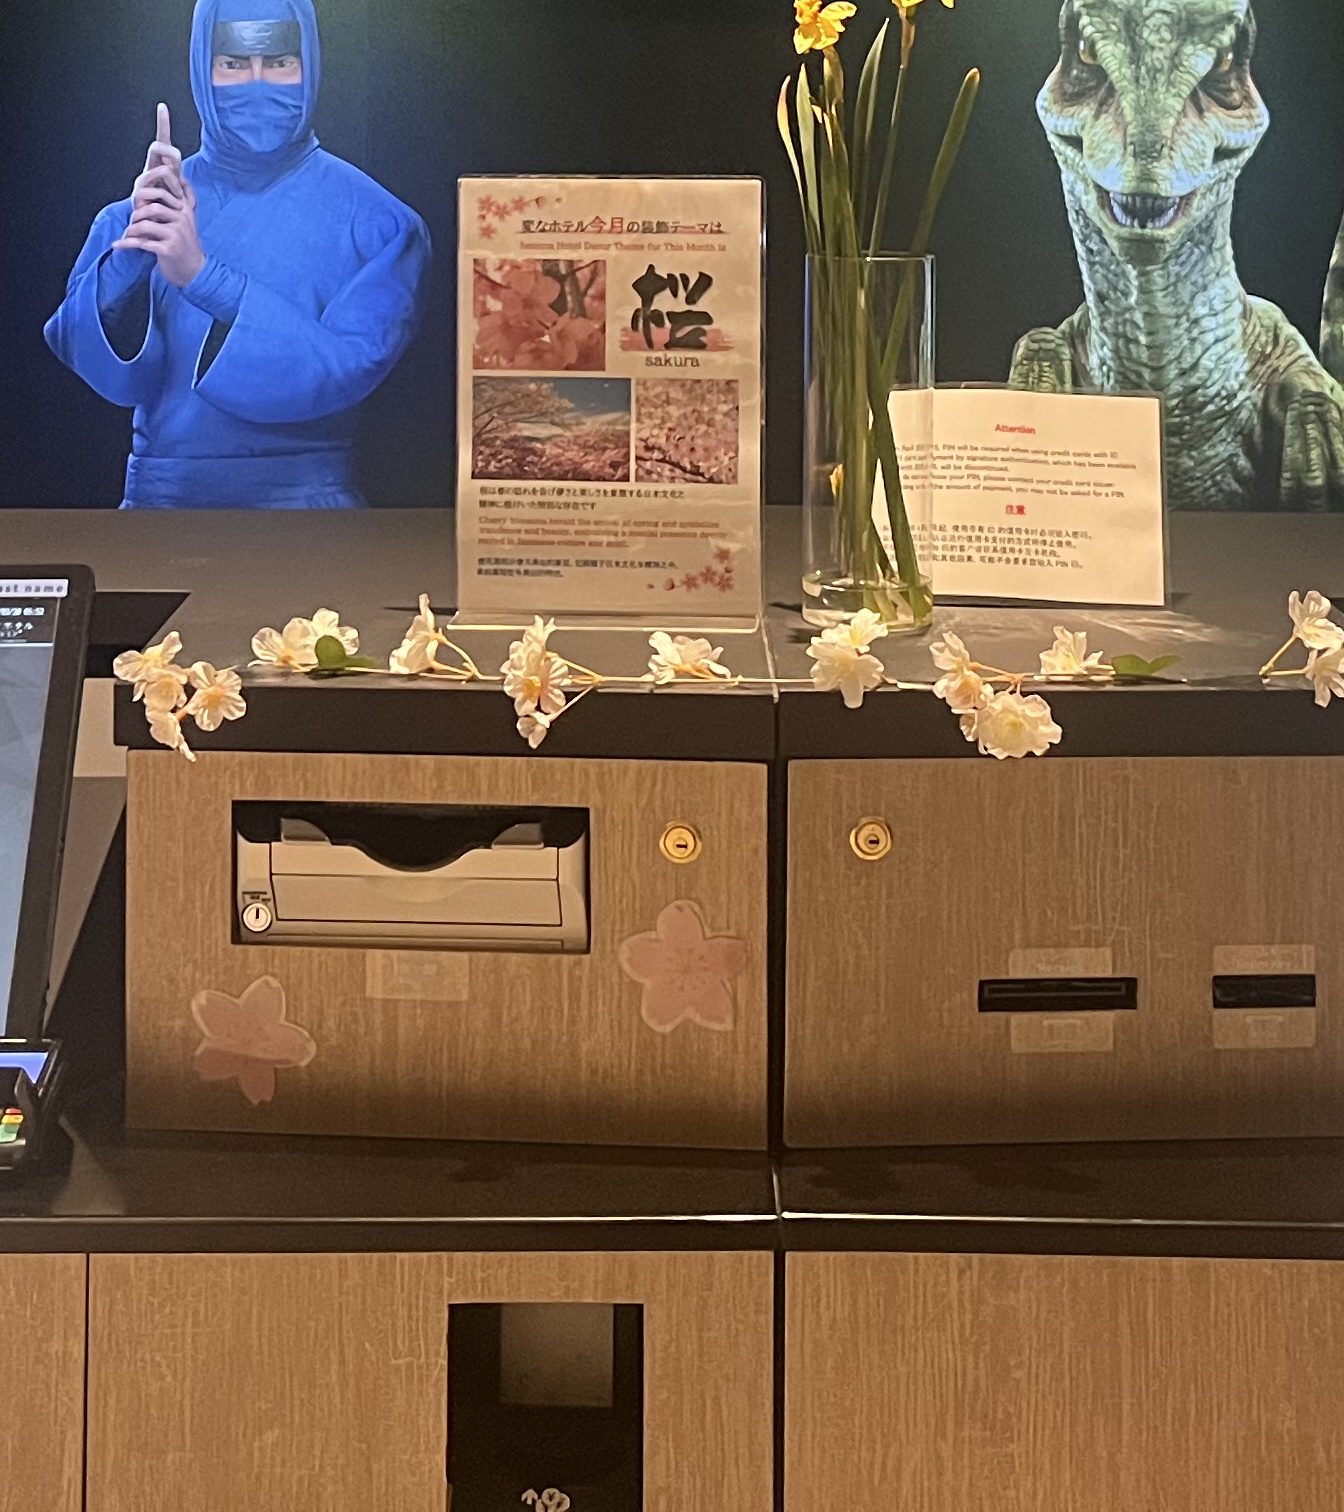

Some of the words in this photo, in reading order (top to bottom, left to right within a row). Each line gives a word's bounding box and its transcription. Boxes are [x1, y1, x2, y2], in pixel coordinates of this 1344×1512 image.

[647, 242, 662, 251] for
[663, 242, 684, 251] This
[630, 263, 714, 350] 桜
[644, 352, 701, 368] sakura
[994, 423, 1036, 435] Attention
